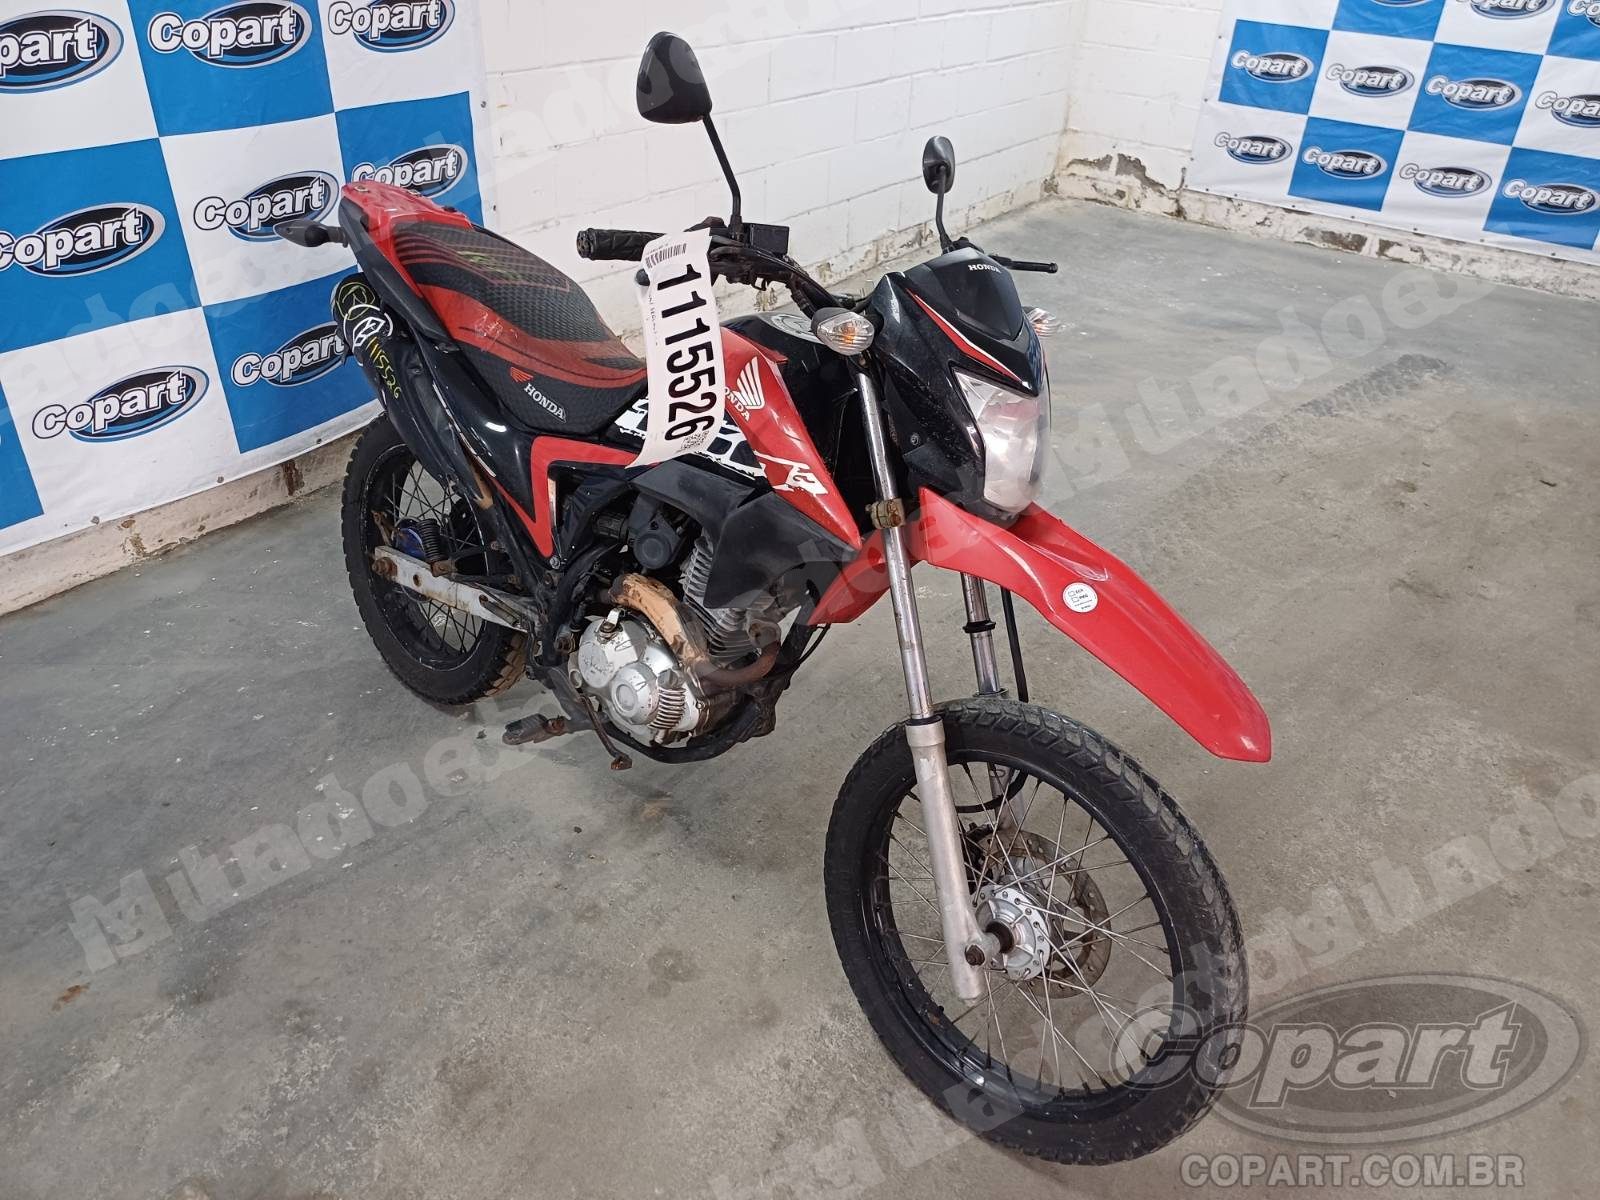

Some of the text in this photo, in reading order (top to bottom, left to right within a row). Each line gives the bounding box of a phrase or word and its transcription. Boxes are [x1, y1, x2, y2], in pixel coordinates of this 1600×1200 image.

[149, 5, 297, 58] Copart
[328, 0, 440, 40] Copart
[1232, 50, 1305, 77] Copart
[1326, 63, 1404, 91] Copart
[1425, 75, 1512, 104] Copart
[1215, 132, 1284, 158] Copart
[1302, 146, 1381, 174] Copart
[352, 148, 458, 188] Copart
[1399, 163, 1482, 191] Copart
[194, 176, 326, 234] Copart
[1503, 179, 1594, 209] Copart
[657, 264, 716, 441] 1115526
[32, 369, 188, 438] Copart
[523, 382, 565, 420] HONDA
[724, 386, 750, 421] ONDA
